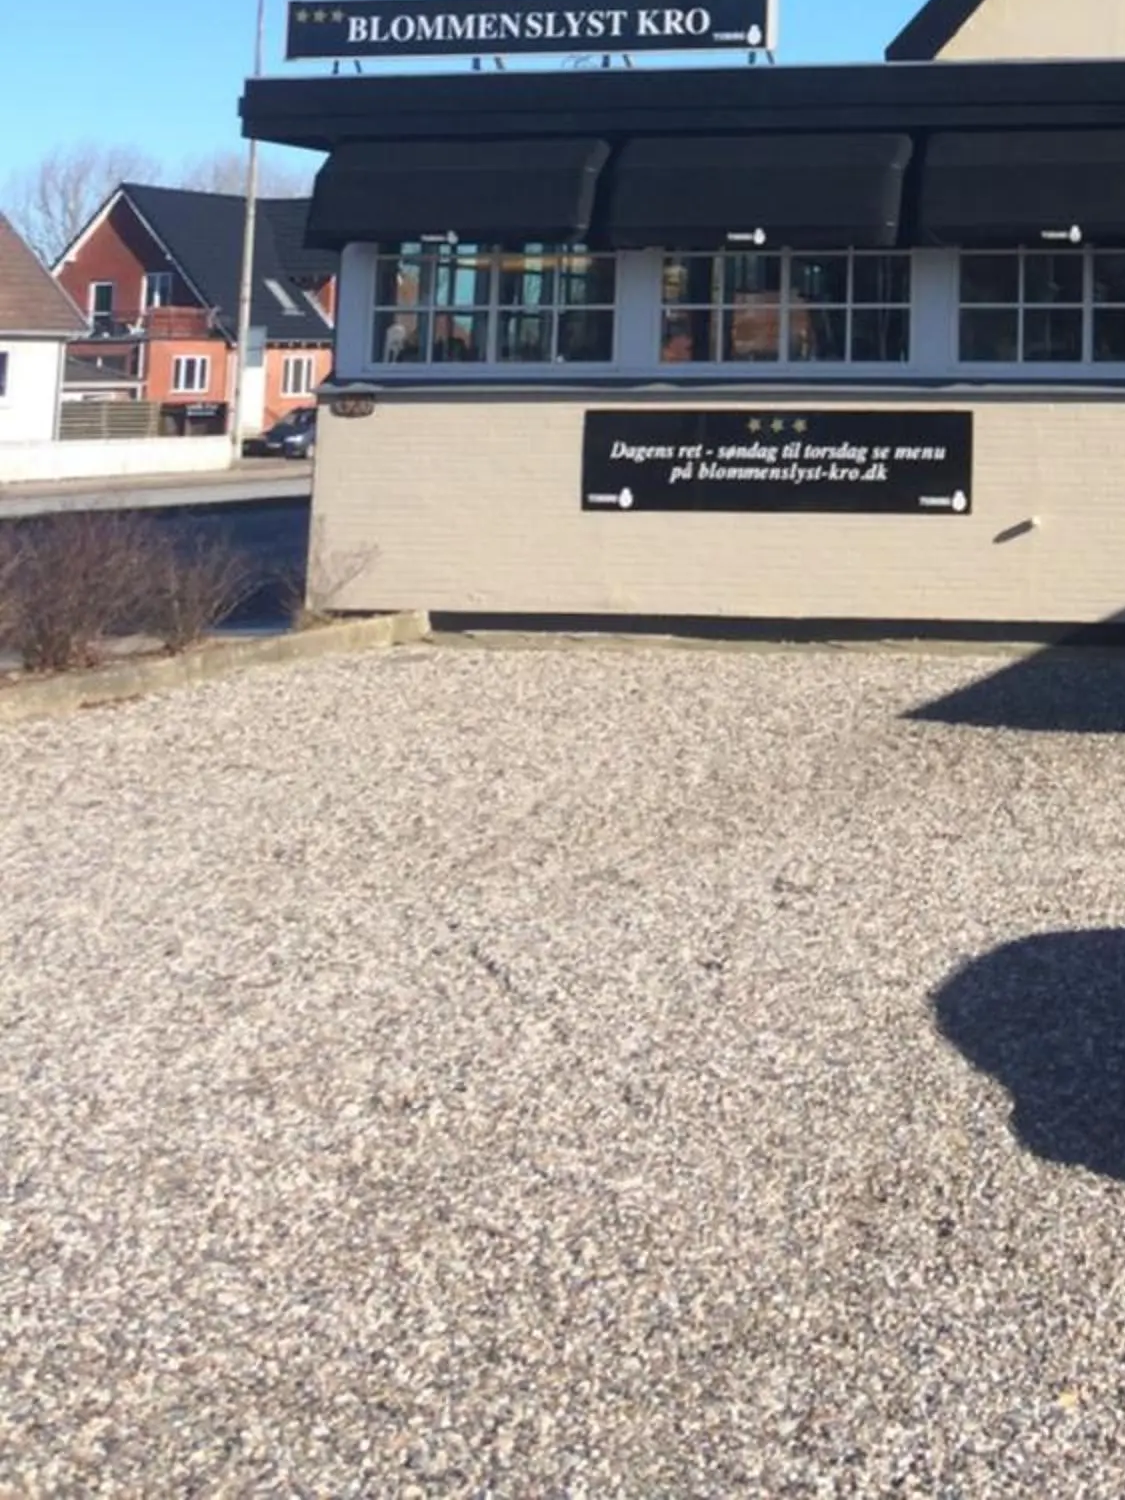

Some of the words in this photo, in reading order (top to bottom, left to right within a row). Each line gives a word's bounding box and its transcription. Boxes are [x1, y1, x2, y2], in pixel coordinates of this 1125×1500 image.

[346, 10, 628, 43] BLOMMENSLYST
[636, 8, 711, 37] KRO
[610, 441, 675, 461] Dagens
[678, 444, 702, 459] ret
[717, 443, 778, 462] søndag
[782, 442, 801, 460] til
[804, 443, 866, 463] torsdag
[872, 447, 890, 460] se
[894, 447, 946, 461] menu
[669, 461, 694, 484] på
[697, 463, 888, 485] blommenslyst-kro.dk
